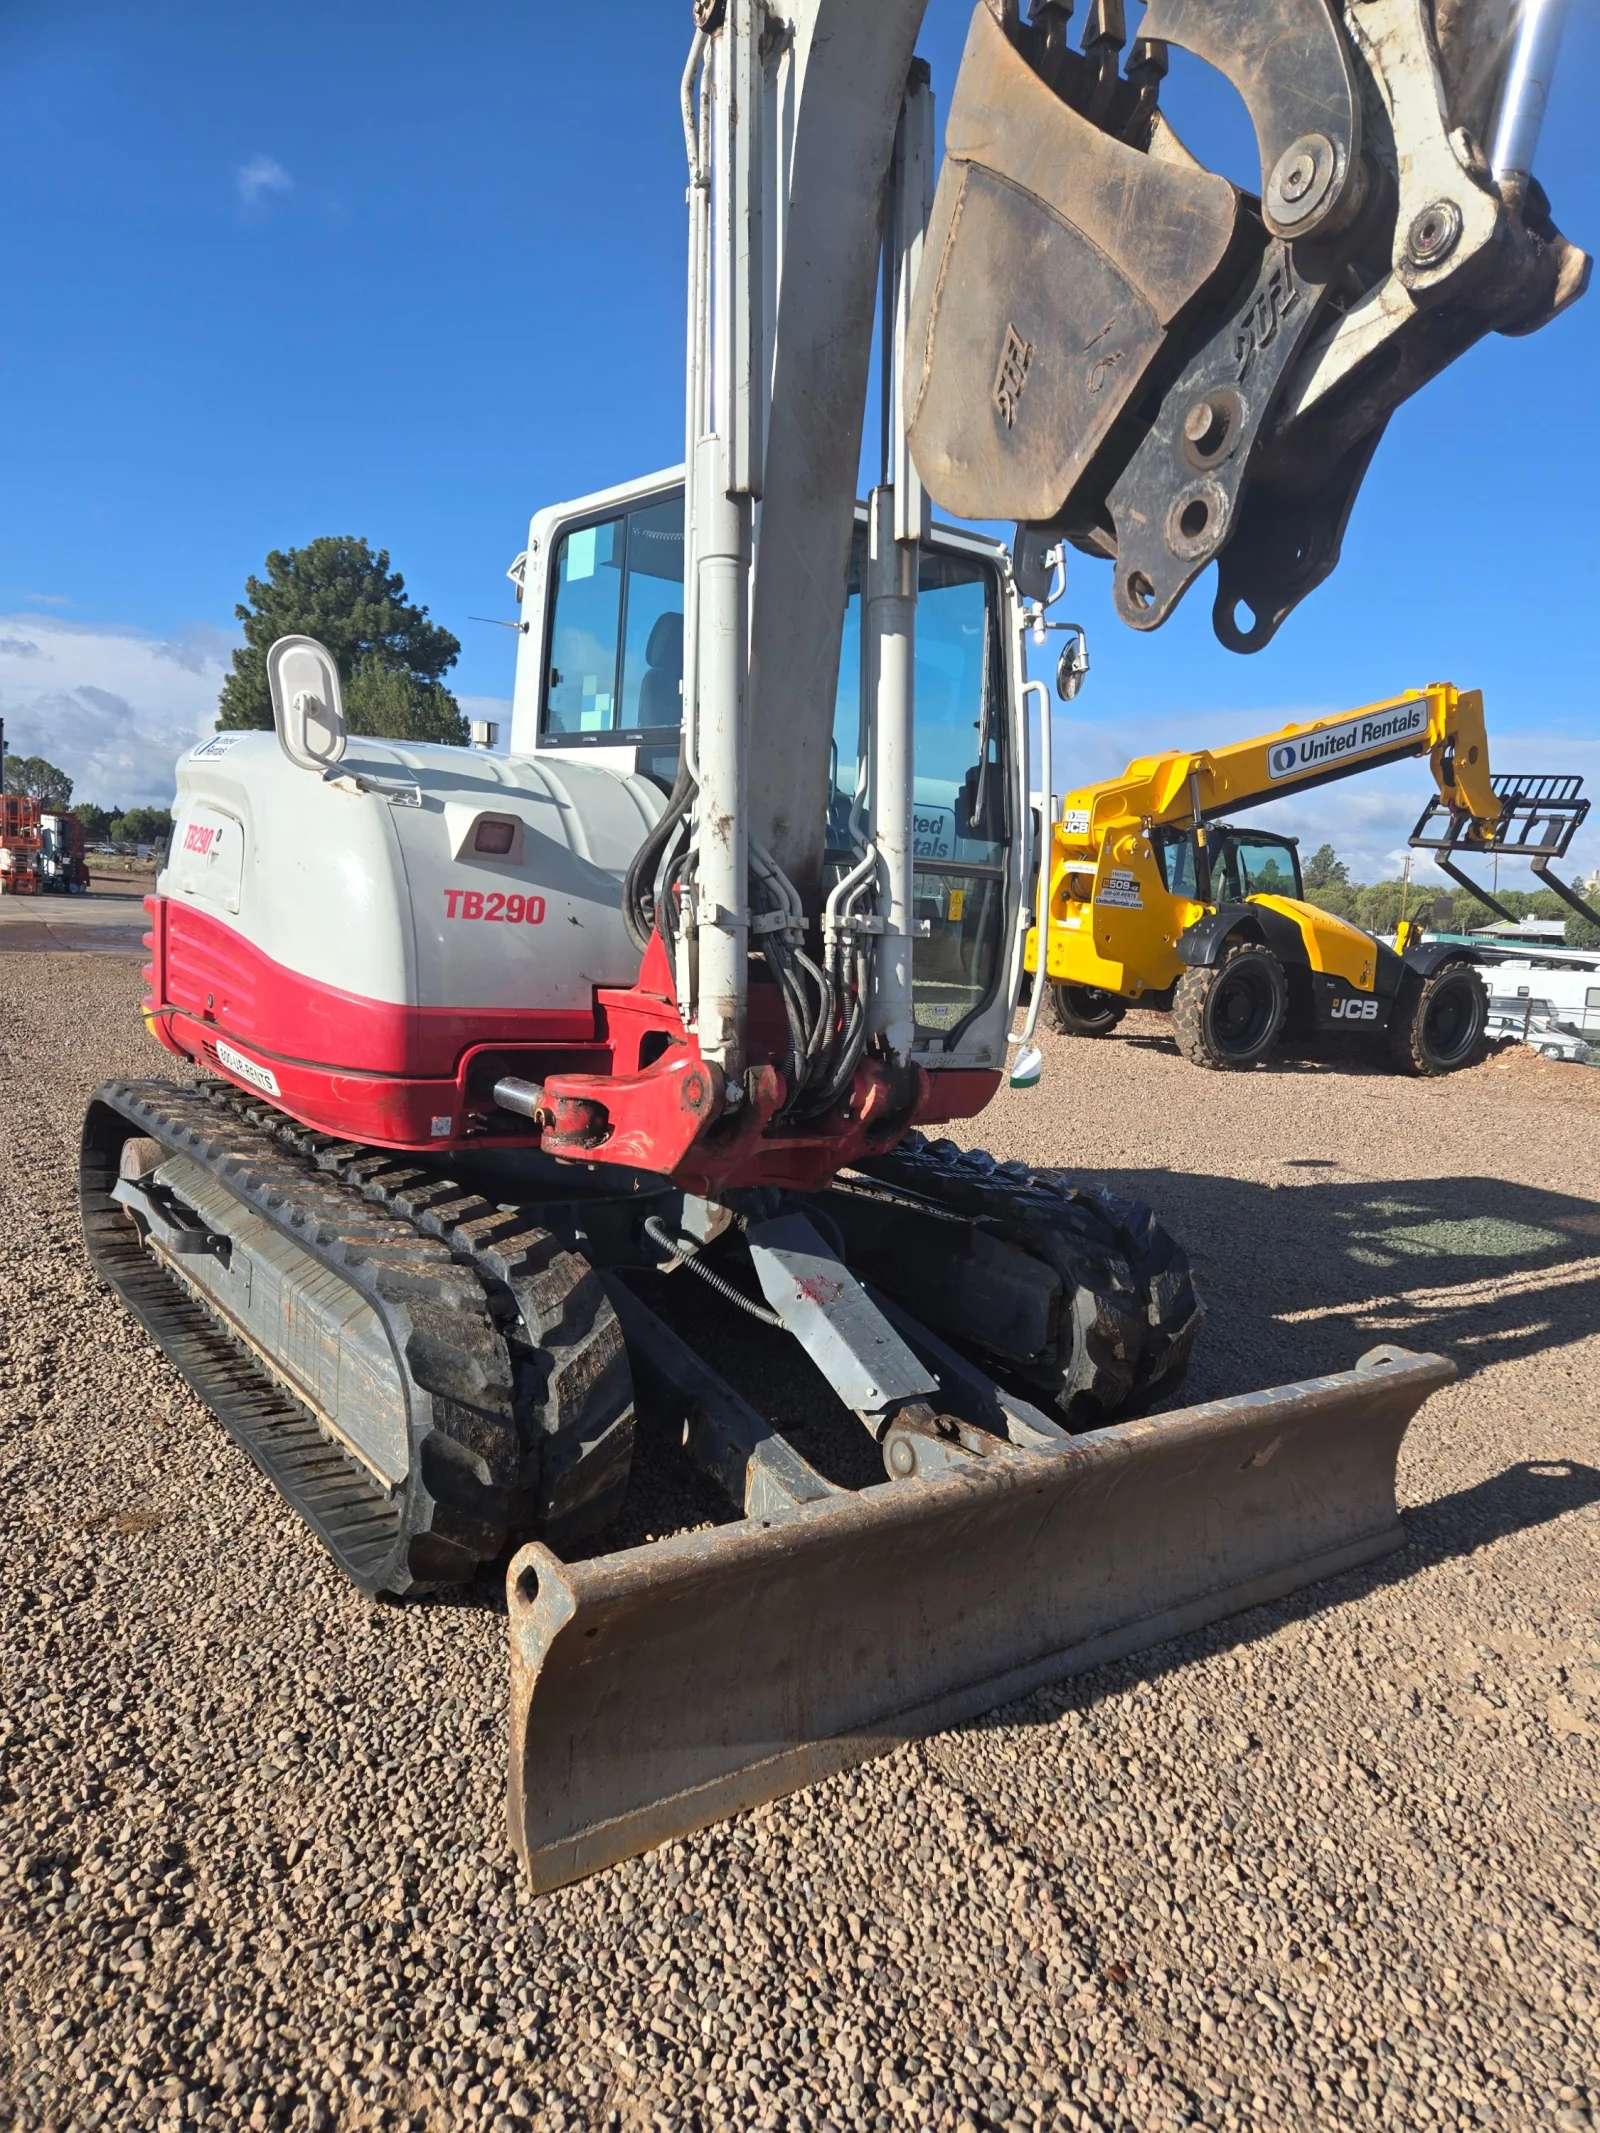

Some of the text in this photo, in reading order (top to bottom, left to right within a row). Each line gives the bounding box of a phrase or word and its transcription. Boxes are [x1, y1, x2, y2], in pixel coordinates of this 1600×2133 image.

[1300, 709, 1421, 763] United Rentals
[913, 815, 944, 835] ted
[1063, 821, 1088, 834] JCB
[183, 824, 214, 855] TB290
[913, 837, 949, 858] tals
[443, 889, 546, 925] TB290
[1331, 999, 1379, 1019] JCB
